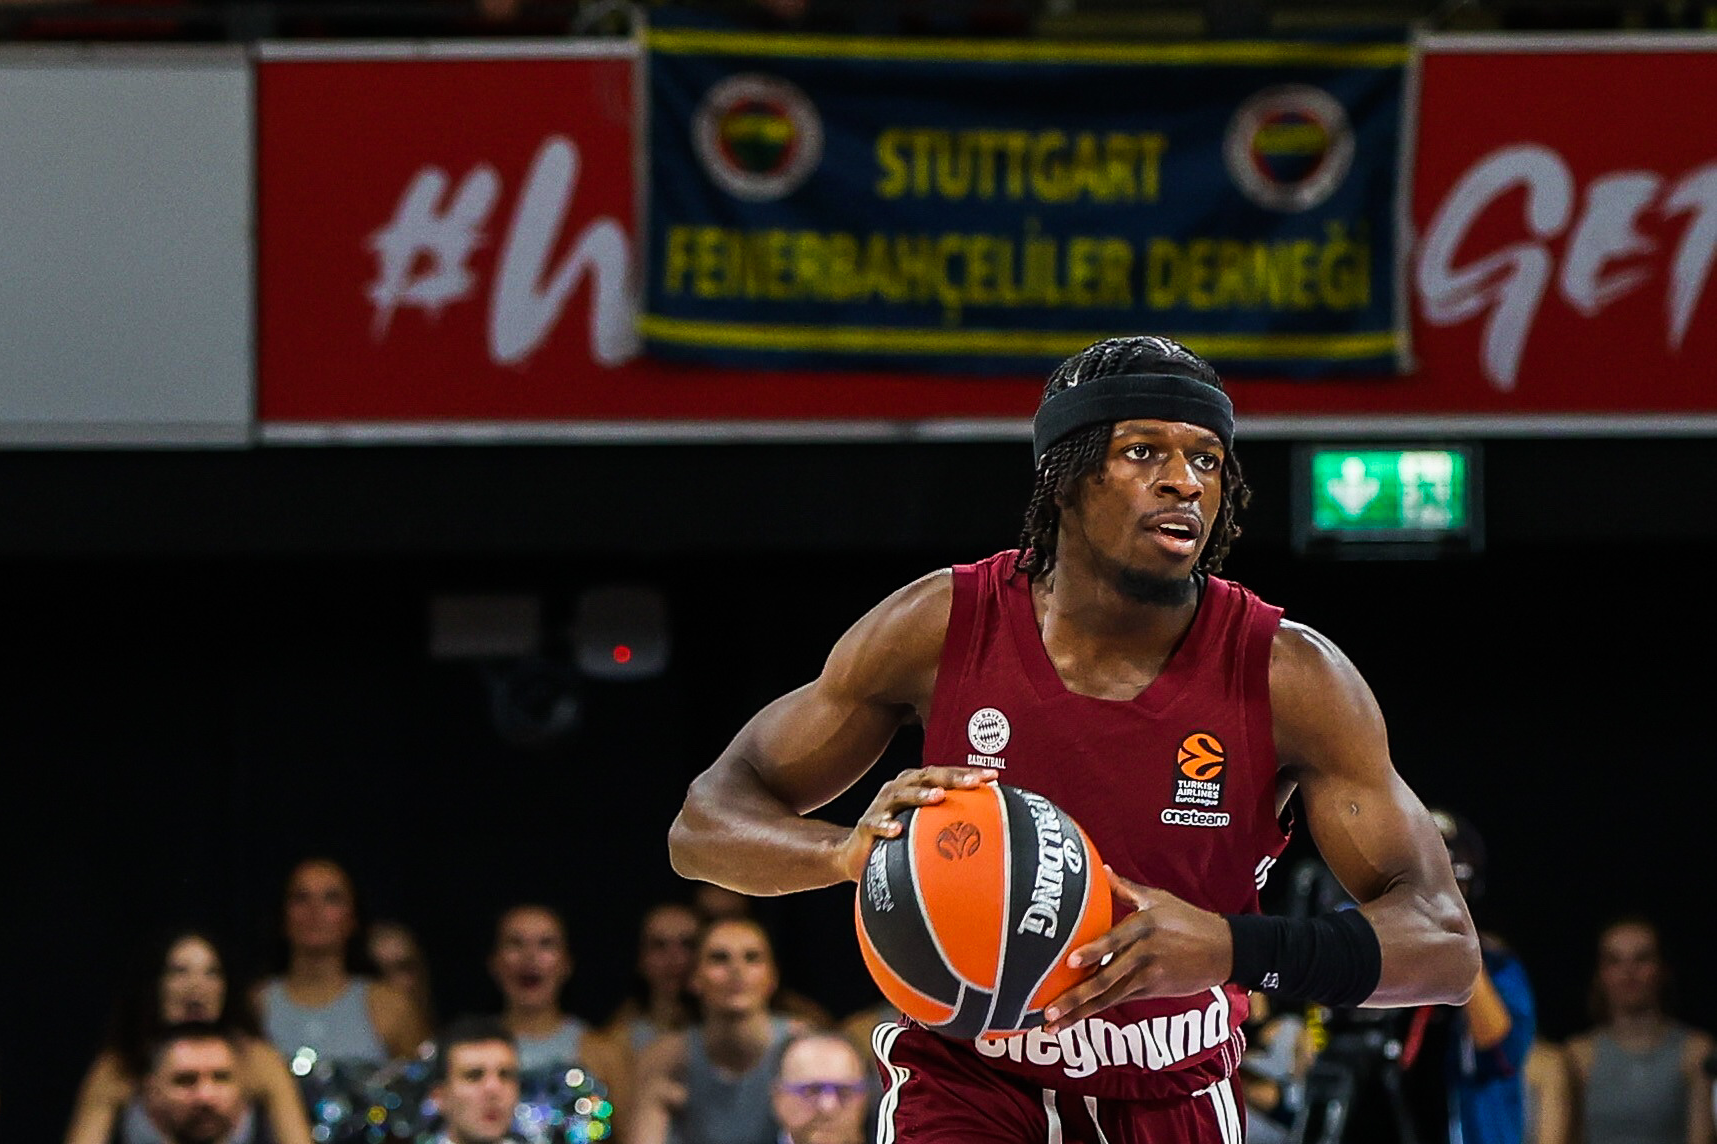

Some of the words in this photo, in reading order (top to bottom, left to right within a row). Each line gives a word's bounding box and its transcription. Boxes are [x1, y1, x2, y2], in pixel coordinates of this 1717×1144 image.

[876, 129, 1167, 203] STUTTGART
[981, 712, 1005, 730] BAYERN
[967, 754, 1006, 769] BASKETBALL
[1177, 780, 1220, 791] TURKISH
[1175, 795, 1218, 806] EuroLeague
[1176, 788, 1219, 799] AIRLINES
[1162, 810, 1229, 826] oneteam
